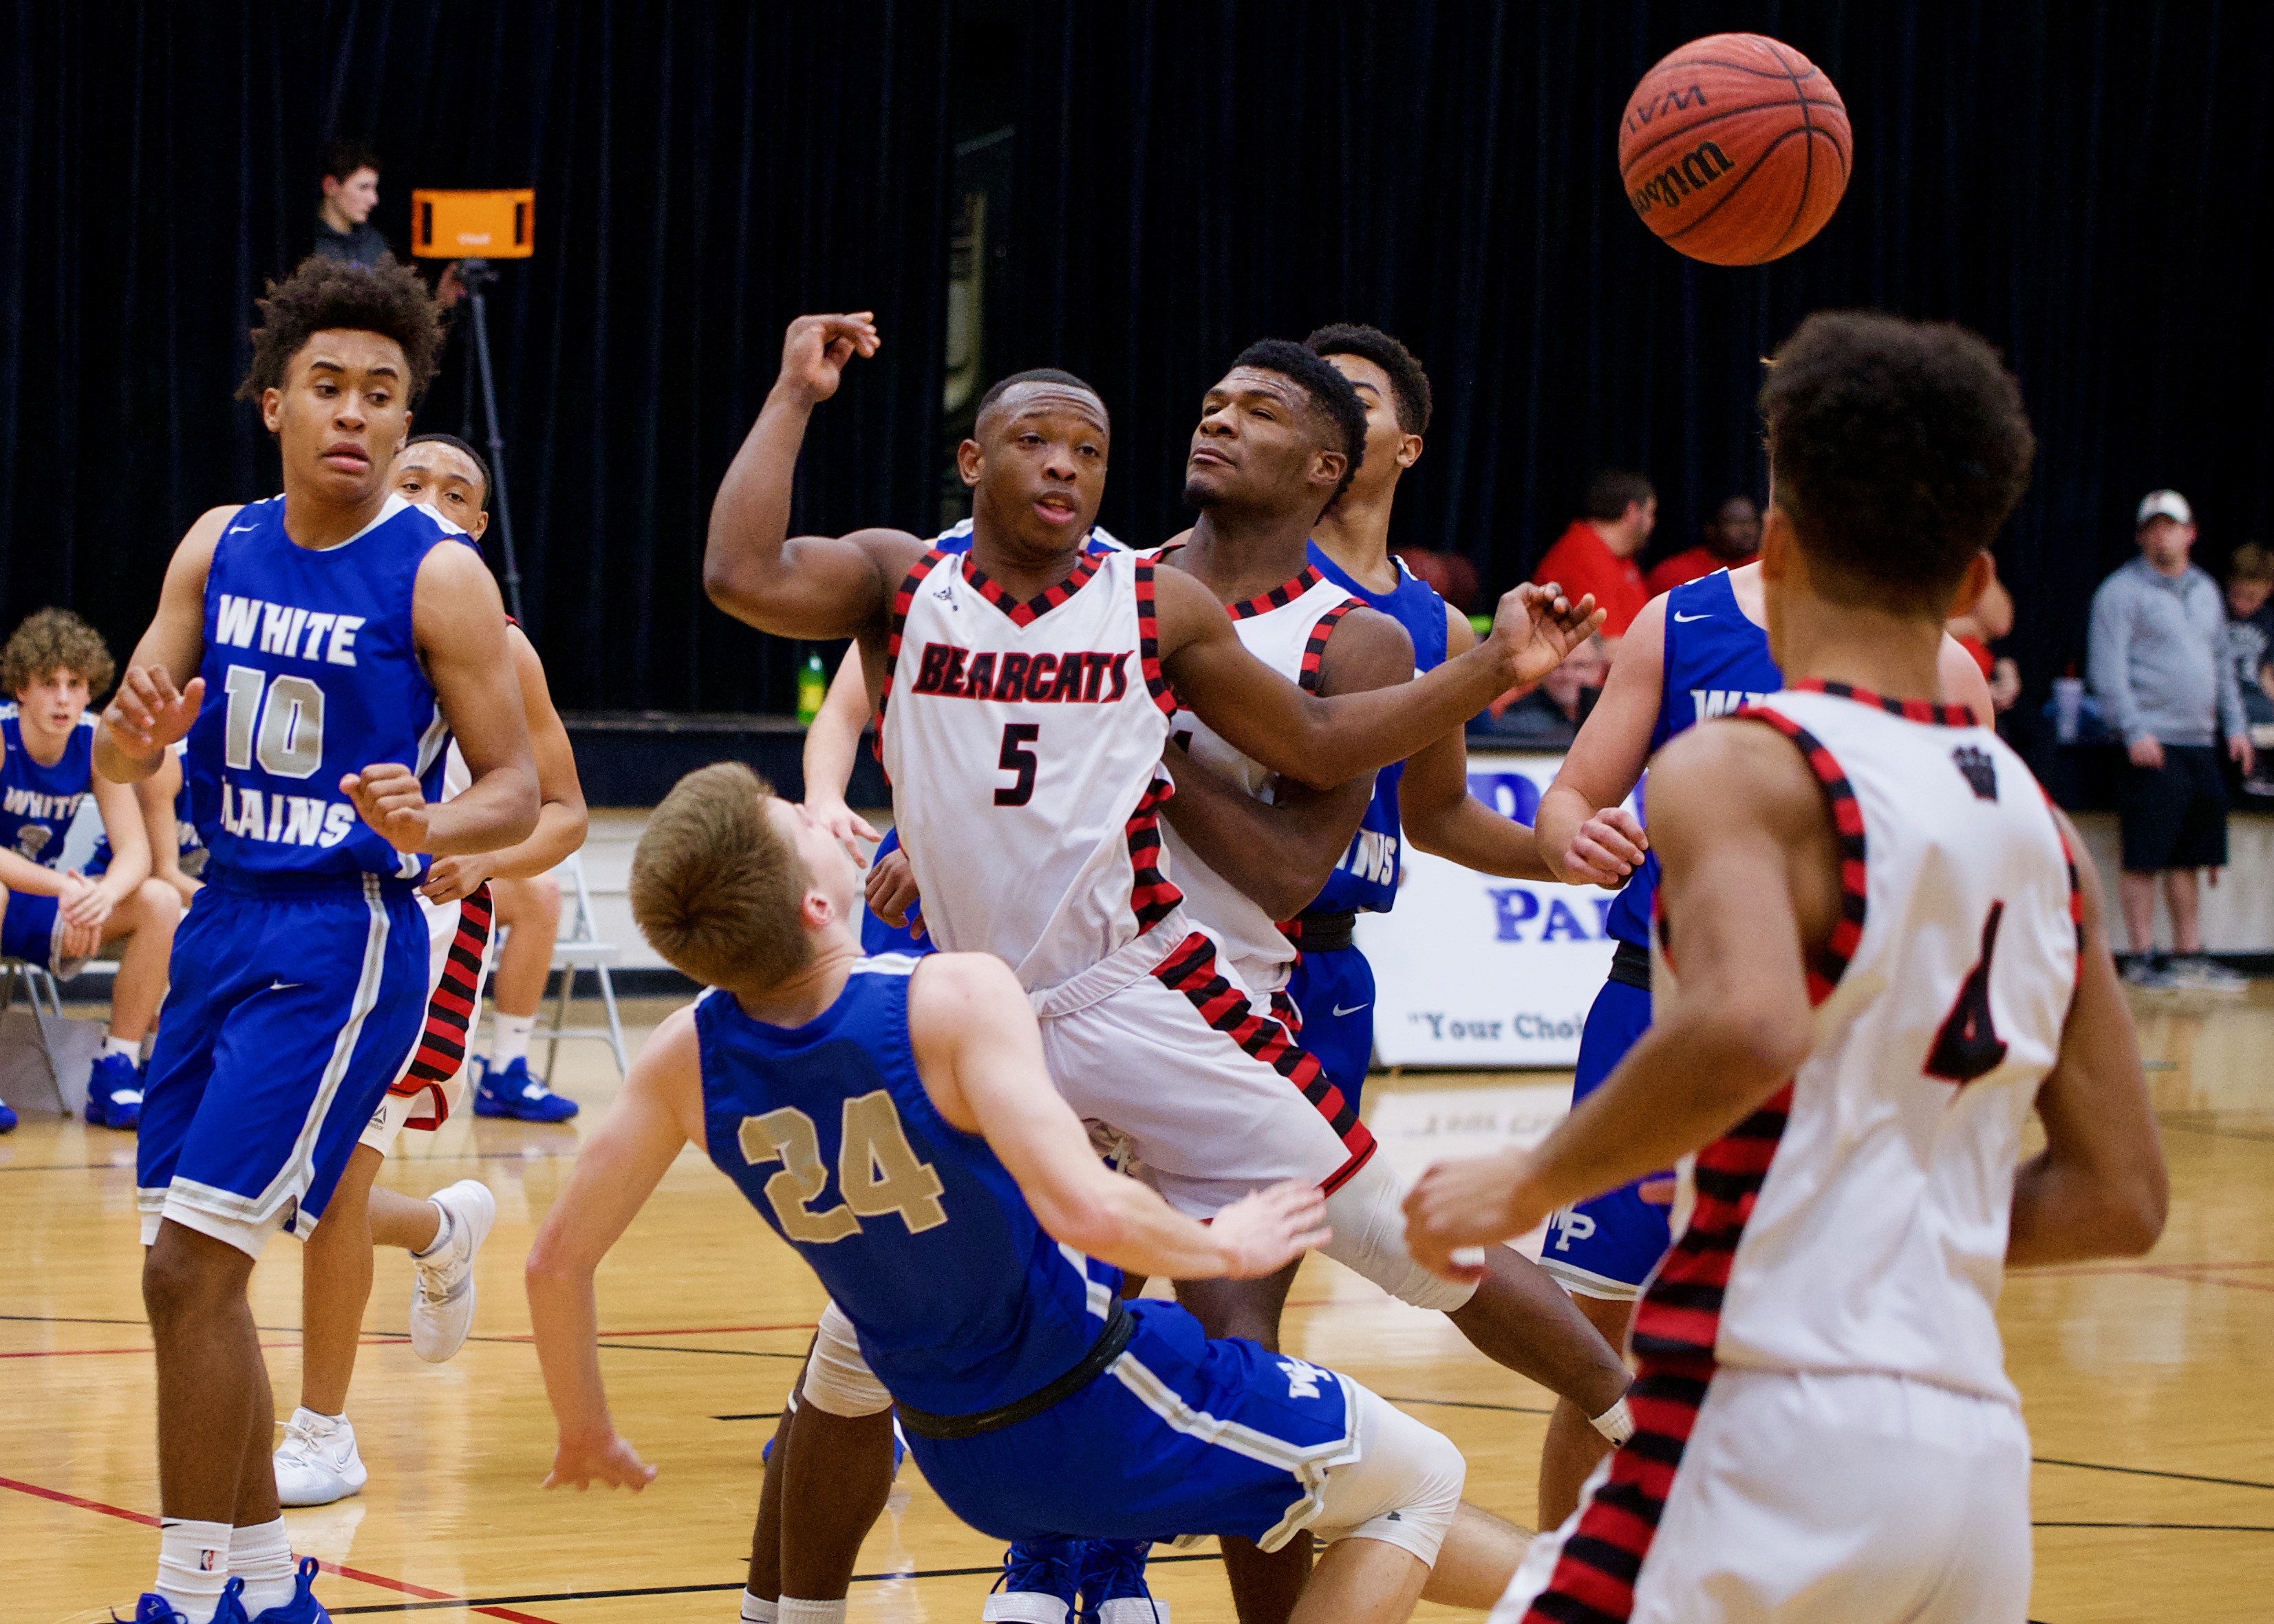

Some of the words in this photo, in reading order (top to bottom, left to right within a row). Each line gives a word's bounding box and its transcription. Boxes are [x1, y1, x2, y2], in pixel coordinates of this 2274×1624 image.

[215, 594, 367, 667] WHITE
[911, 642, 1135, 704] BEARCATS
[224, 664, 325, 780] 10
[994, 723, 1040, 807] 5
[220, 775, 356, 849] LAINS
[1922, 898, 2008, 1084] 4
[737, 1089, 949, 1244] 24
